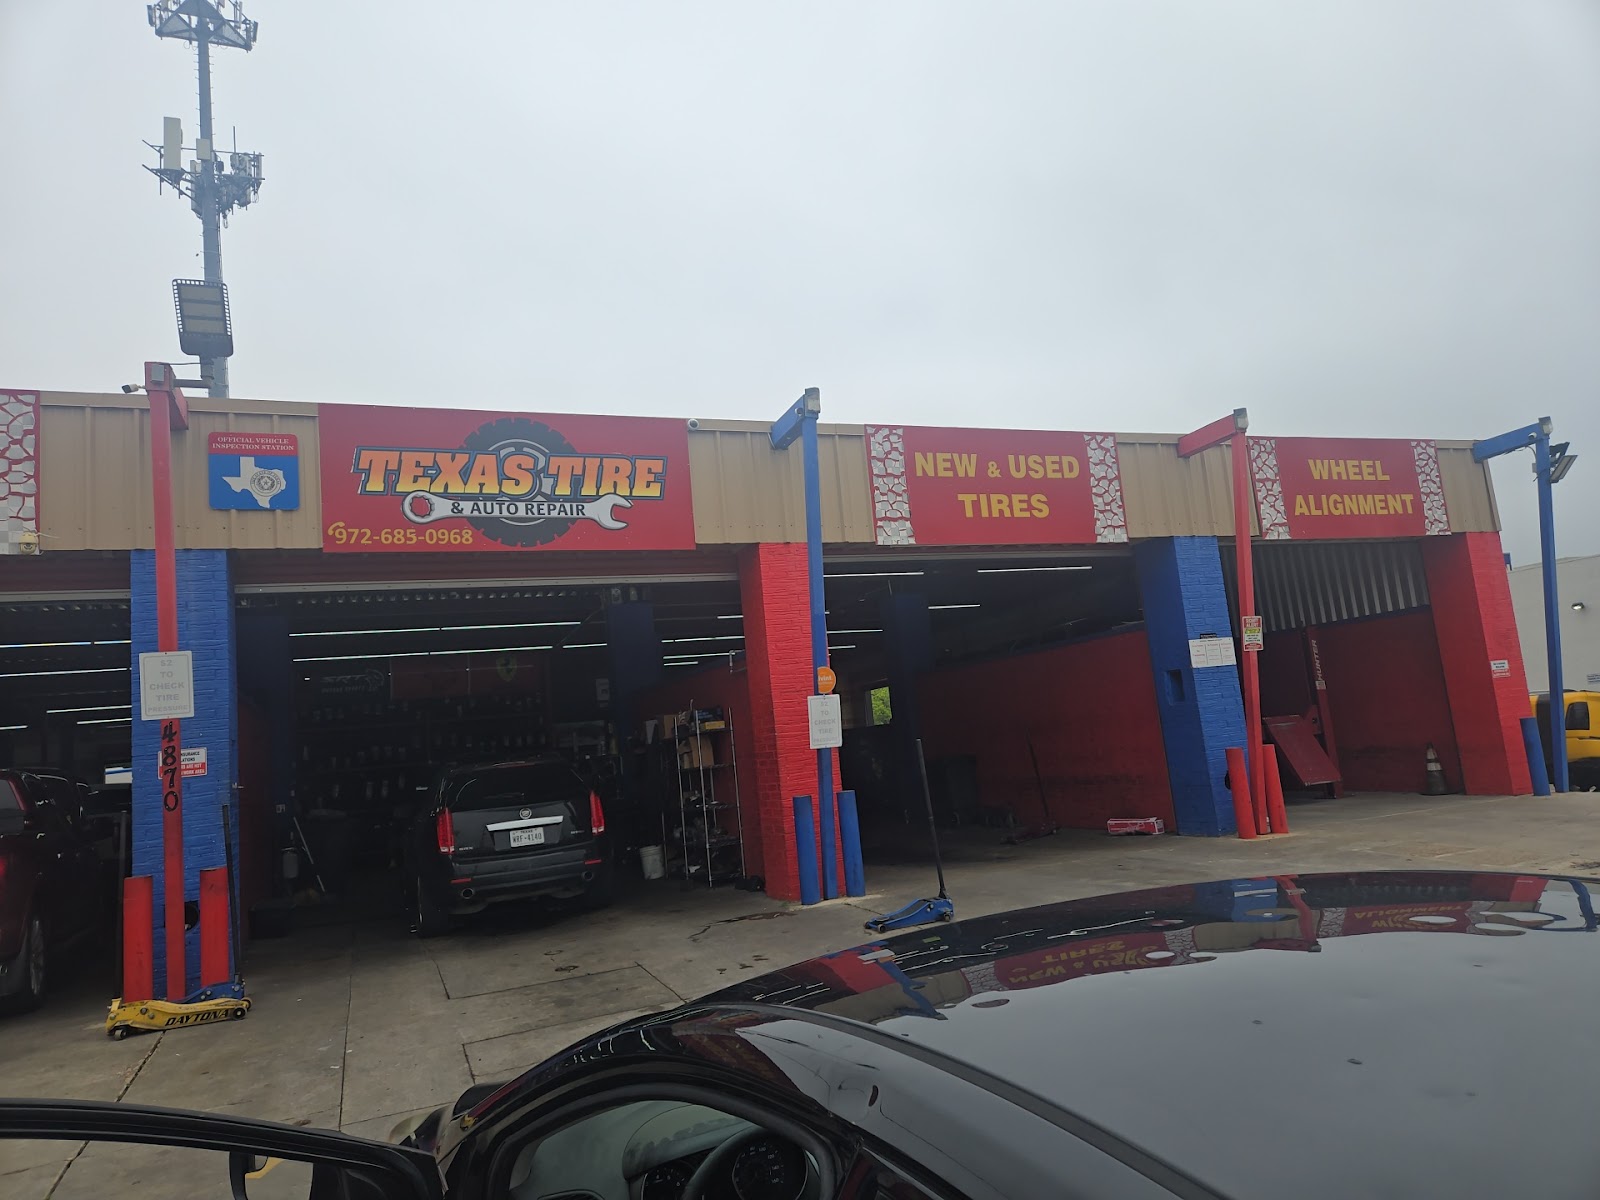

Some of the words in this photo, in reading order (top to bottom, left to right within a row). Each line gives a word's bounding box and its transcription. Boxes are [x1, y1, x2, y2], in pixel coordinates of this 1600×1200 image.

[255, 437, 289, 445] VEHICLE
[354, 447, 539, 498] TEXAS
[545, 455, 667, 499] TIRE
[914, 452, 977, 478] NEW
[987, 461, 1002, 478] &
[1008, 454, 1080, 479] USED
[1307, 459, 1391, 481] WHEEL
[450, 501, 464, 515] &
[470, 501, 519, 516] AUTO
[524, 501, 586, 516] REPAIR
[957, 493, 1050, 519] TIRES
[1294, 493, 1414, 516] ALIGNMENT
[334, 527, 474, 545] 972-685-0968
[1311, 639, 1323, 681] HUNTER
[160, 671, 174, 679] TO
[149, 682, 185, 691] CHECK
[155, 693, 180, 702] TIRE
[148, 704, 189, 713] PRESSURE
[814, 718, 836, 726] CHECK
[162, 721, 180, 813] 4870
[165, 1009, 230, 1026] DAYTONA
